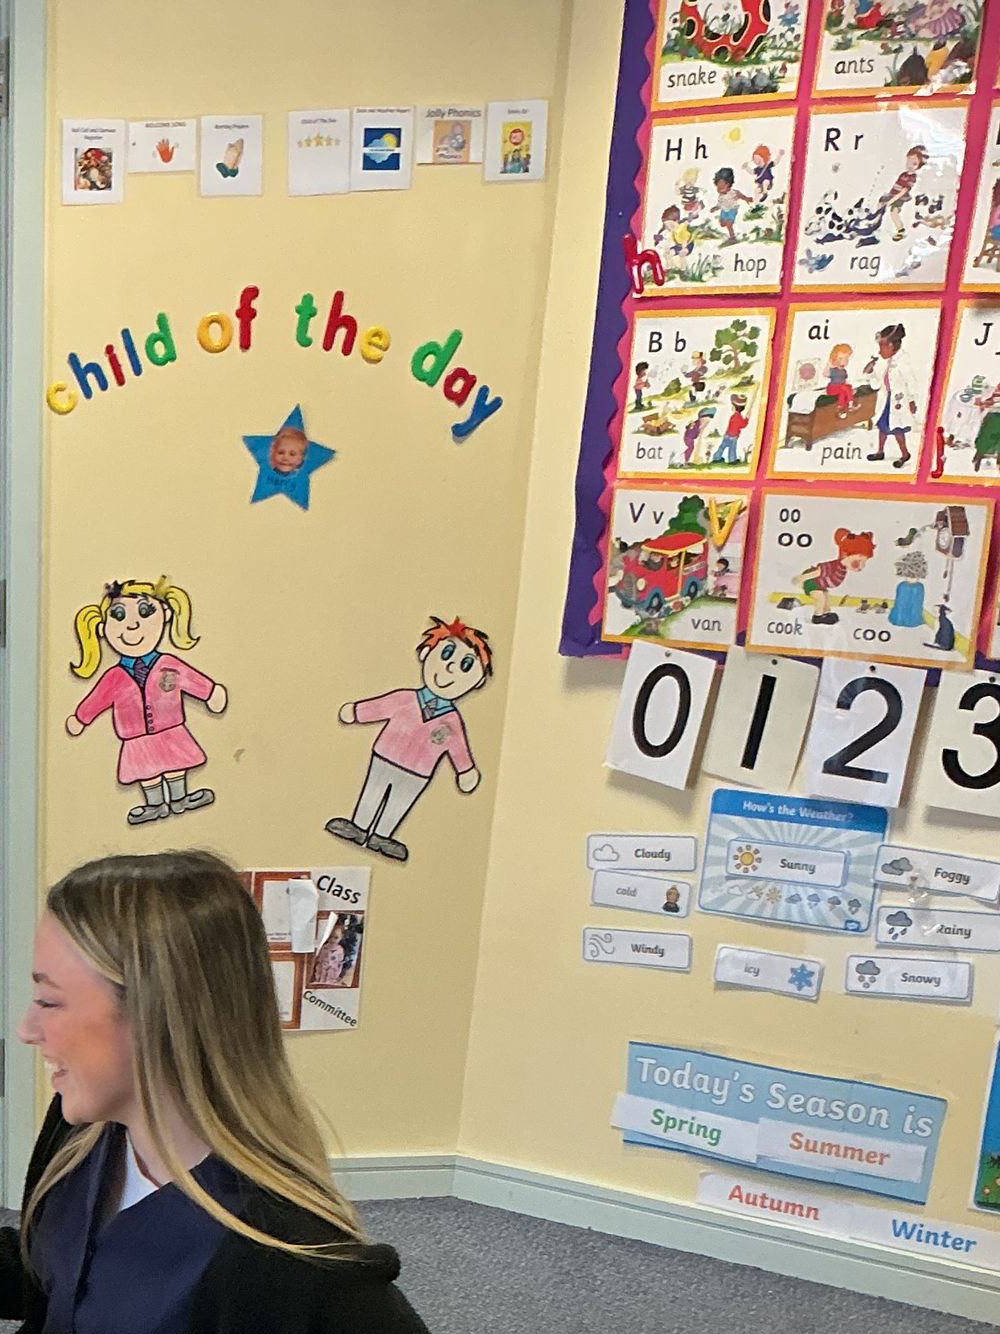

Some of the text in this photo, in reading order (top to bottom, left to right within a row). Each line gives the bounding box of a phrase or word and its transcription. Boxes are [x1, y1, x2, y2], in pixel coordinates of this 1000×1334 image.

[834, 56, 875, 75] ants
[667, 66, 717, 88] snake
[426, 107, 482, 118] Jolly Phonics
[665, 137, 709, 161] H h
[824, 127, 864, 151] R r
[734, 252, 767, 281] hop
[850, 252, 880, 276] rag
[808, 319, 831, 340] ai
[974, 323, 993, 346] J
[648, 331, 686, 353] B b
[46, 284, 502, 442] child of the day
[636, 442, 663, 460] bat
[822, 443, 862, 469] pain
[629, 502, 664, 524] V v
[779, 508, 801, 523] oo
[777, 532, 813, 547] oo
[691, 617, 722, 632] van
[767, 619, 803, 636] cook
[853, 627, 891, 642] coo
[633, 663, 691, 758] 0
[822, 677, 903, 784] 2
[941, 682, 1000, 790] 3
[743, 801, 854, 822] How's the Weather?
[634, 848, 671, 861] Cloudy
[779, 858, 816, 874] Sunny
[934, 867, 971, 885] Foggy
[317, 875, 361, 904] Class
[616, 887, 637, 897] cold
[631, 943, 665, 958] Windy
[744, 964, 760, 977] icy
[901, 972, 941, 988] Snowy
[303, 990, 357, 1027] Committee
[635, 1056, 935, 1138] Today's Season is
[650, 1108, 722, 1146] Spring
[789, 1132, 891, 1166] Summer
[728, 1184, 820, 1221] Autumn
[891, 1218, 978, 1253] Winter
